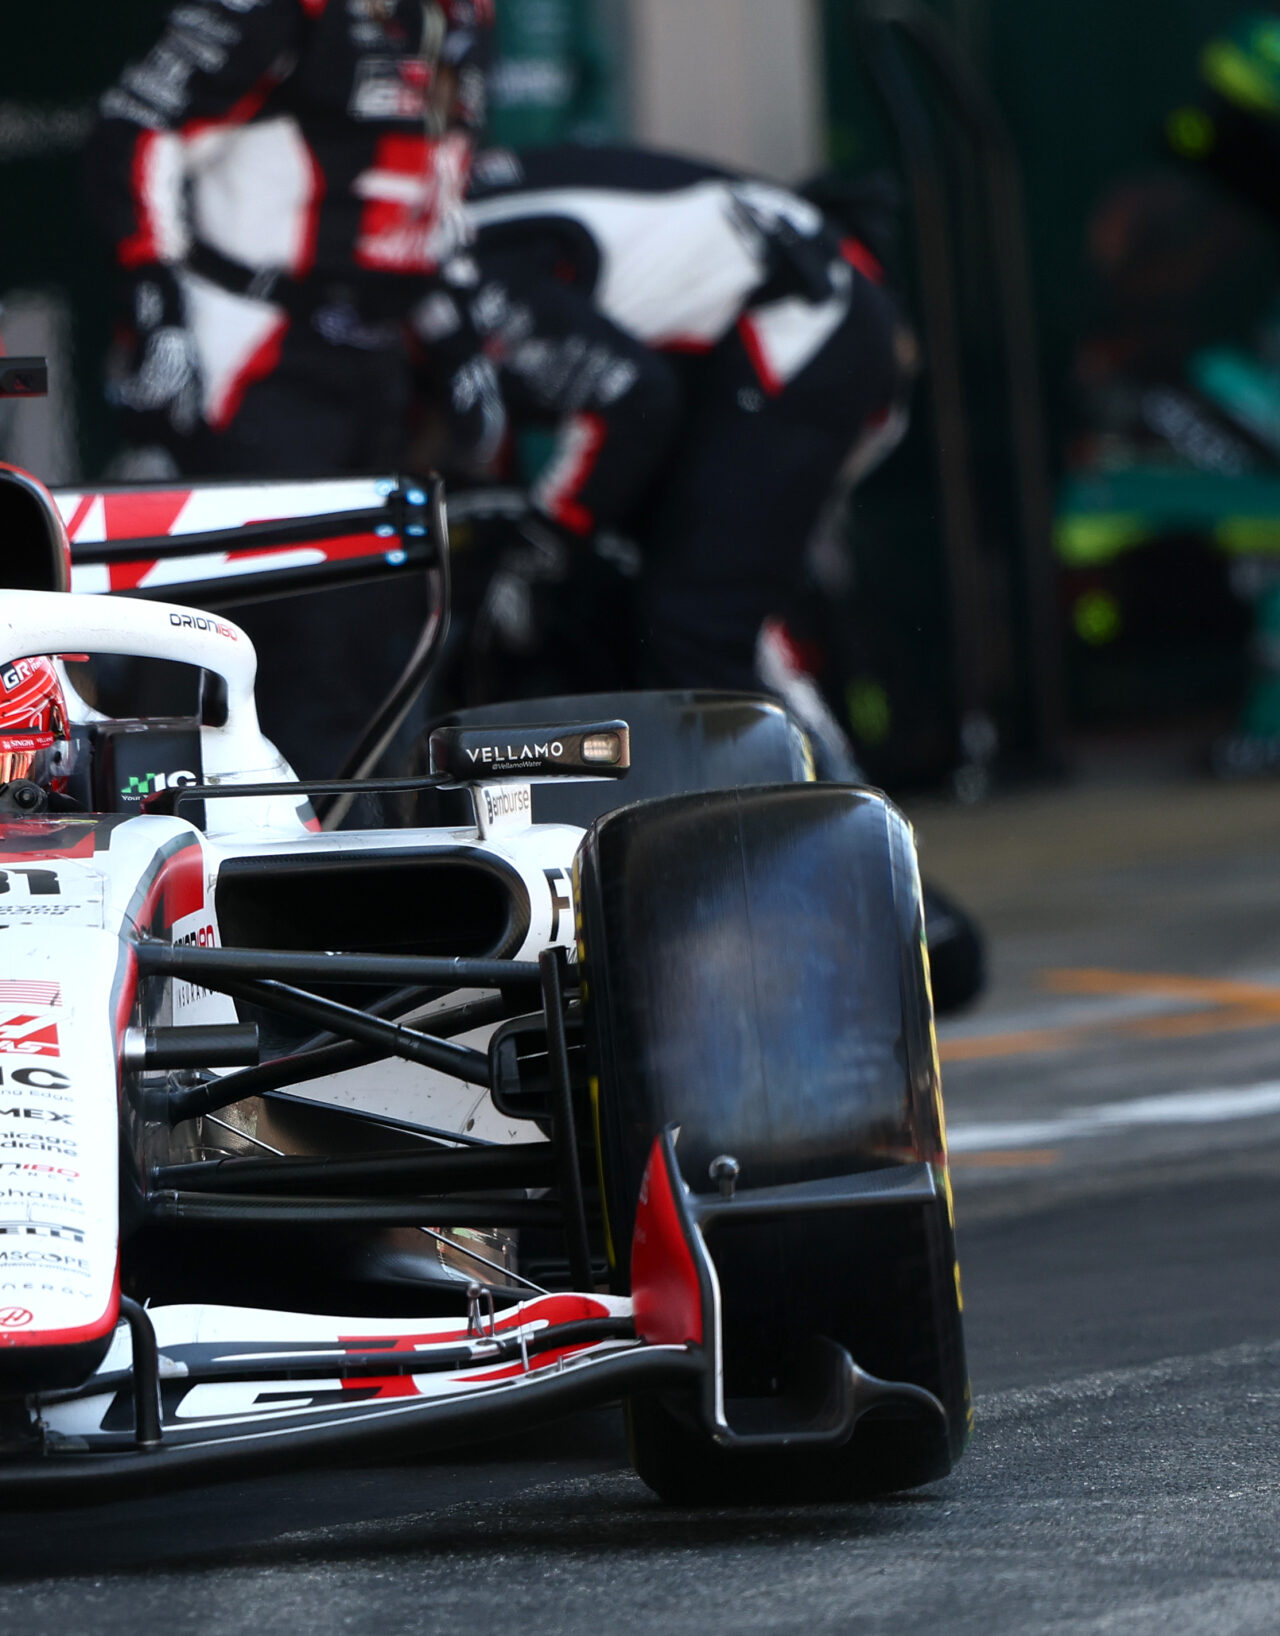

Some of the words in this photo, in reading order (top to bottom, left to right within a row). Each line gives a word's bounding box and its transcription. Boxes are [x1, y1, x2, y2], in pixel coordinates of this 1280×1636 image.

[466, 741, 564, 764] VELLAMO
[492, 787, 530, 818] emburse
[30, 1090, 75, 1102] Edge
